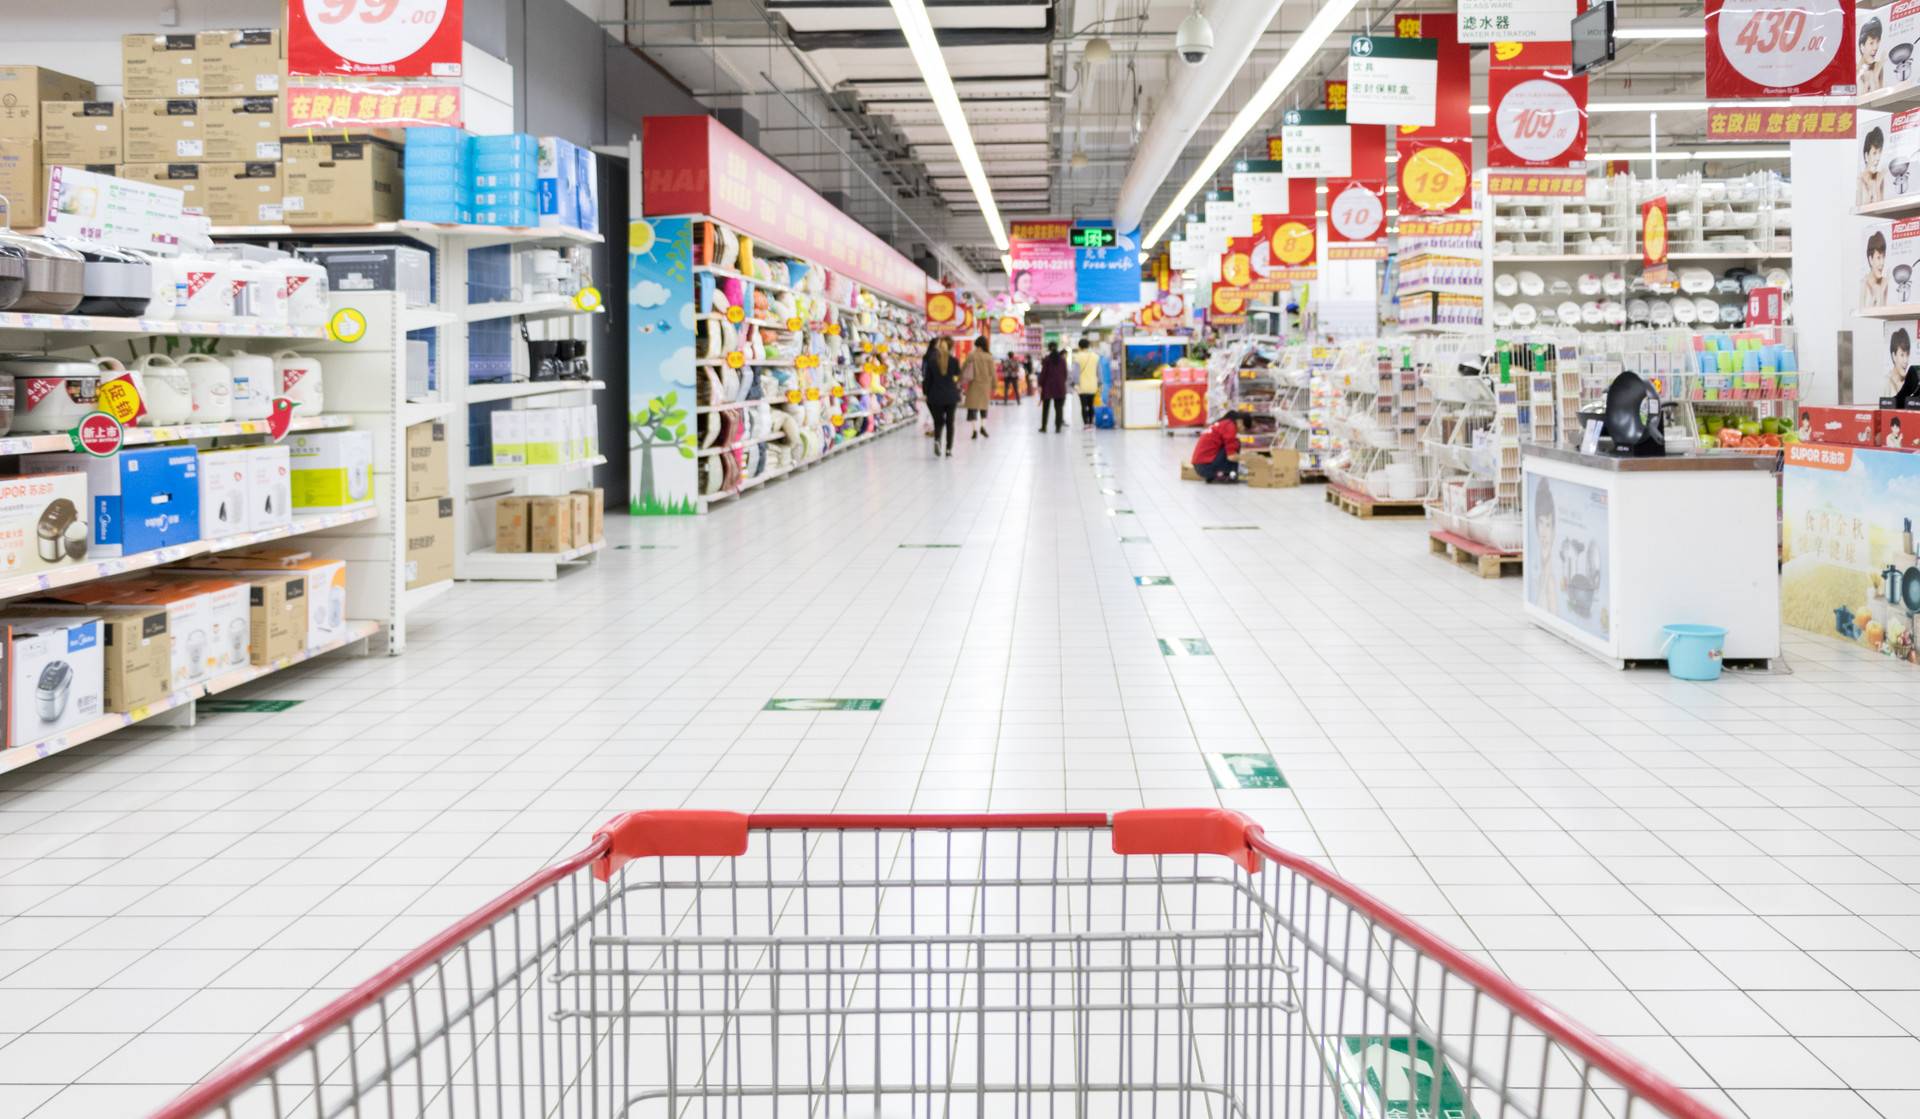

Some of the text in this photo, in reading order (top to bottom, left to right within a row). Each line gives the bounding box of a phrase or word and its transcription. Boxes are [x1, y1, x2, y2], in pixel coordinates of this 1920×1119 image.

[1463, 15, 1510, 29] 滤水器
[1355, 41, 1370, 53] 14
[291, 94, 457, 119] 在欧尚 您省得更多
[1711, 112, 1854, 134] 在欧尚 您省得更多
[1083, 260, 1106, 269] Free
[83, 427, 118, 438] 新上市
[1791, 446, 1845, 464] SUPOR 苏泊尔
